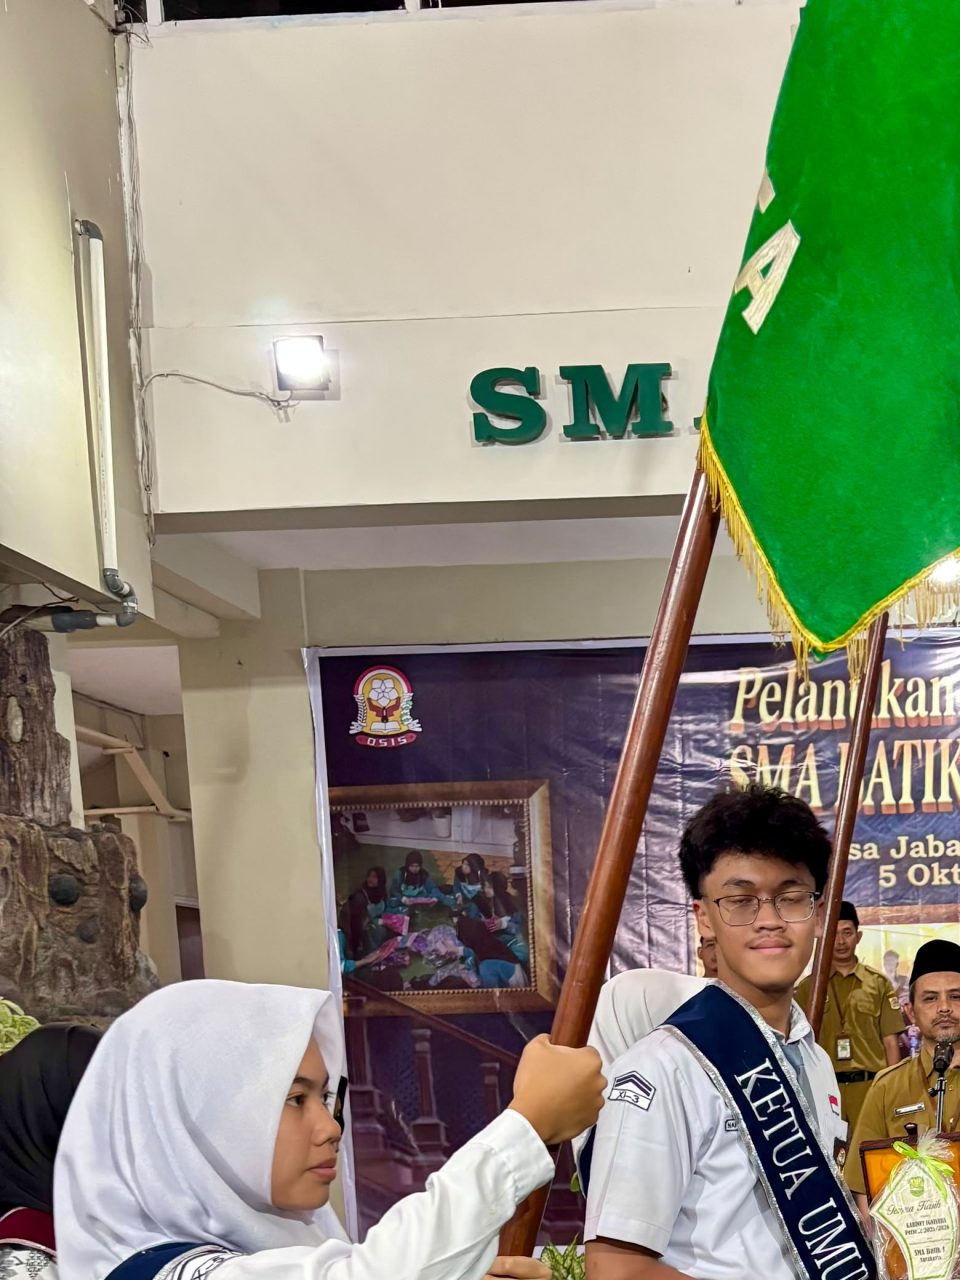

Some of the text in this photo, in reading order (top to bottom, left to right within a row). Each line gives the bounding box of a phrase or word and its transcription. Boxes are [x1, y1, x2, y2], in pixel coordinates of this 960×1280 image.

[469, 362, 704, 446] SM
[367, 736, 407, 747] OSIS
[879, 864, 897, 888] 5
[734, 1058, 819, 1201] KETUA
